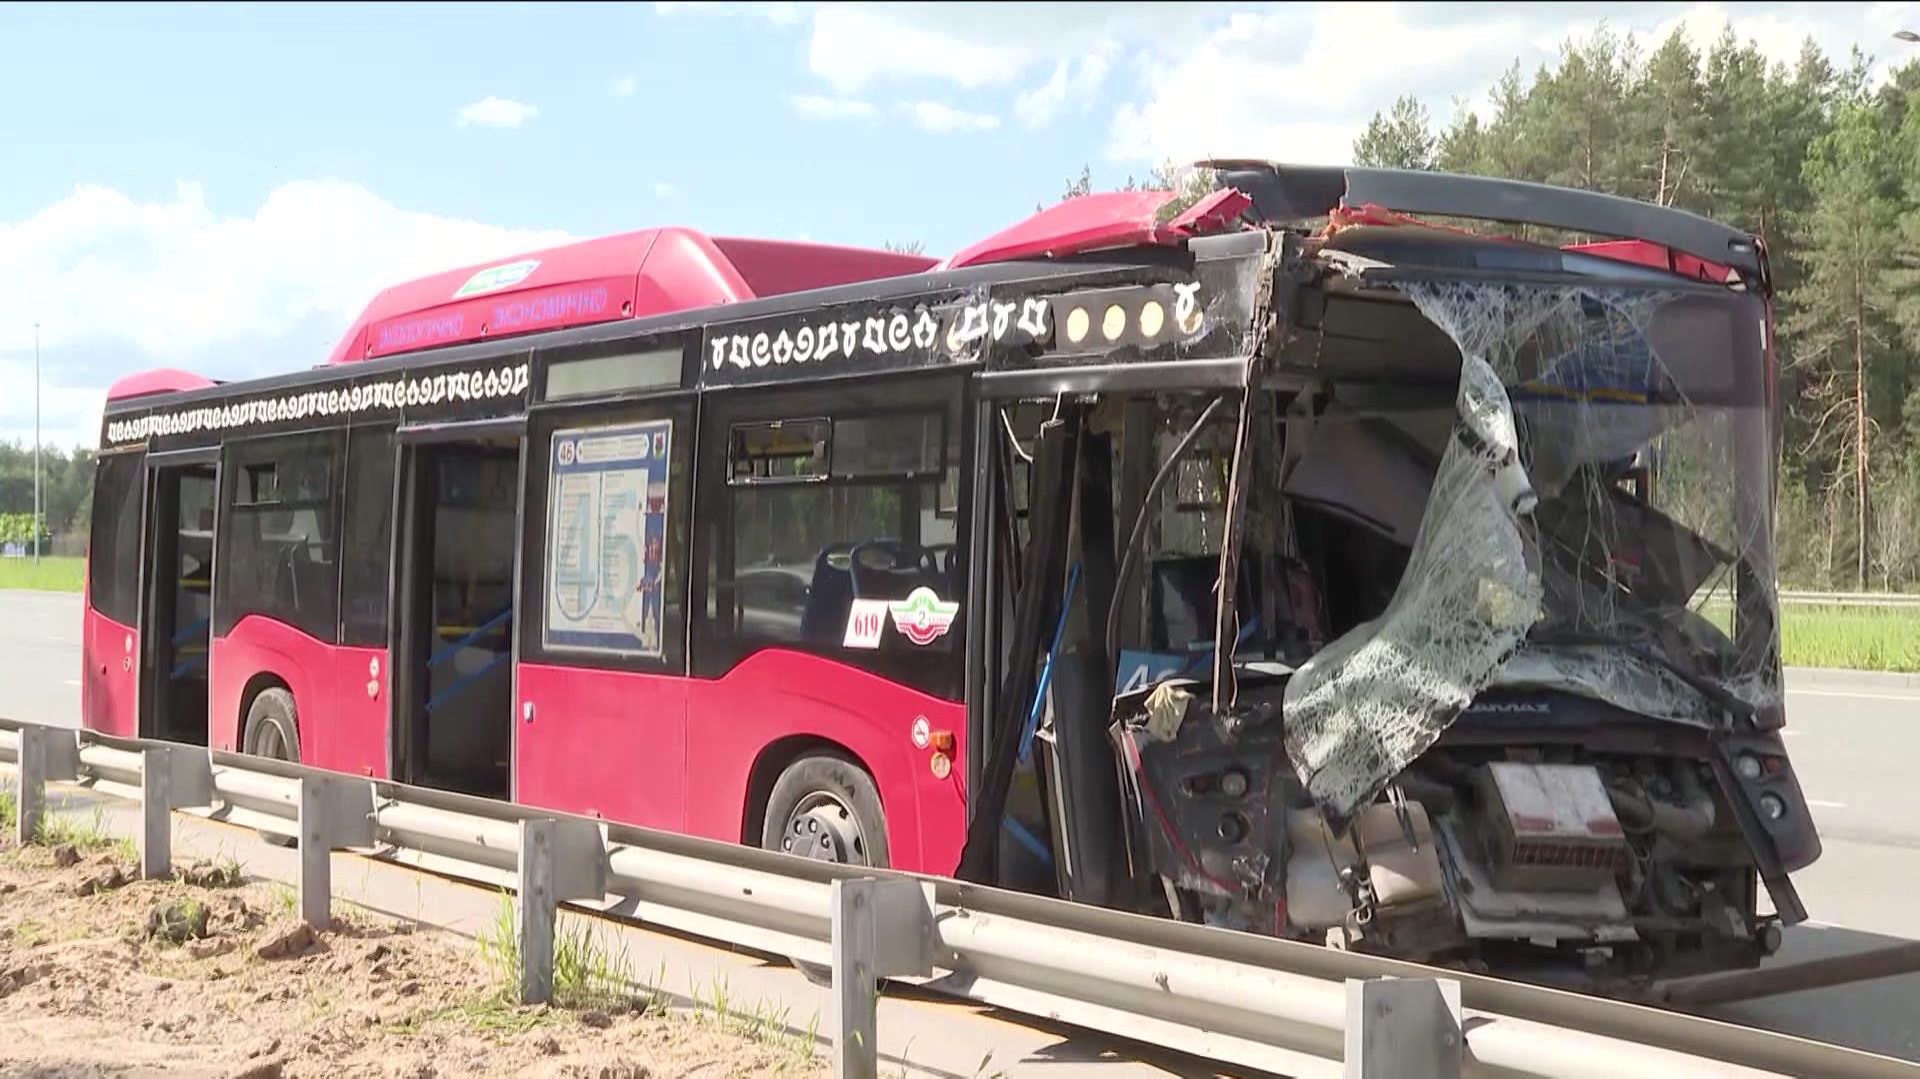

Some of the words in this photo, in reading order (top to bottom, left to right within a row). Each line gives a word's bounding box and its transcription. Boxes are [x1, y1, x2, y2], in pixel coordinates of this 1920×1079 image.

[560, 442, 573, 461] 46
[855, 612, 879, 637] 619
[919, 610, 925, 626] 2
